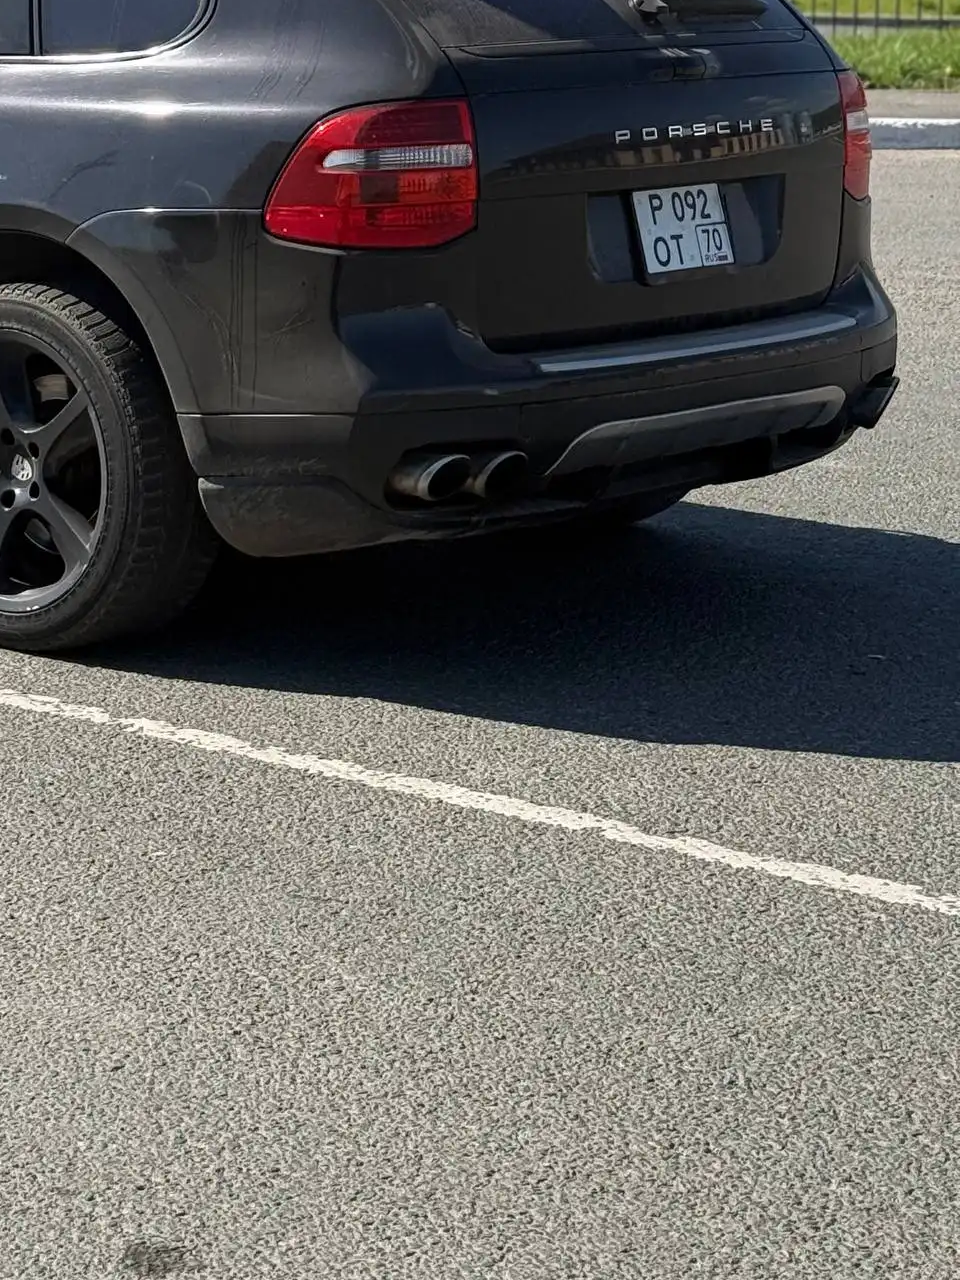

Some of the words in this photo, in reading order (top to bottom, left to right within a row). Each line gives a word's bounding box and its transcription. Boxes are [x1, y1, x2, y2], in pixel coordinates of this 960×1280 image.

[615, 119, 774, 144] PORSCHE
[670, 188, 712, 223] 092
[701, 228, 723, 253] 70
